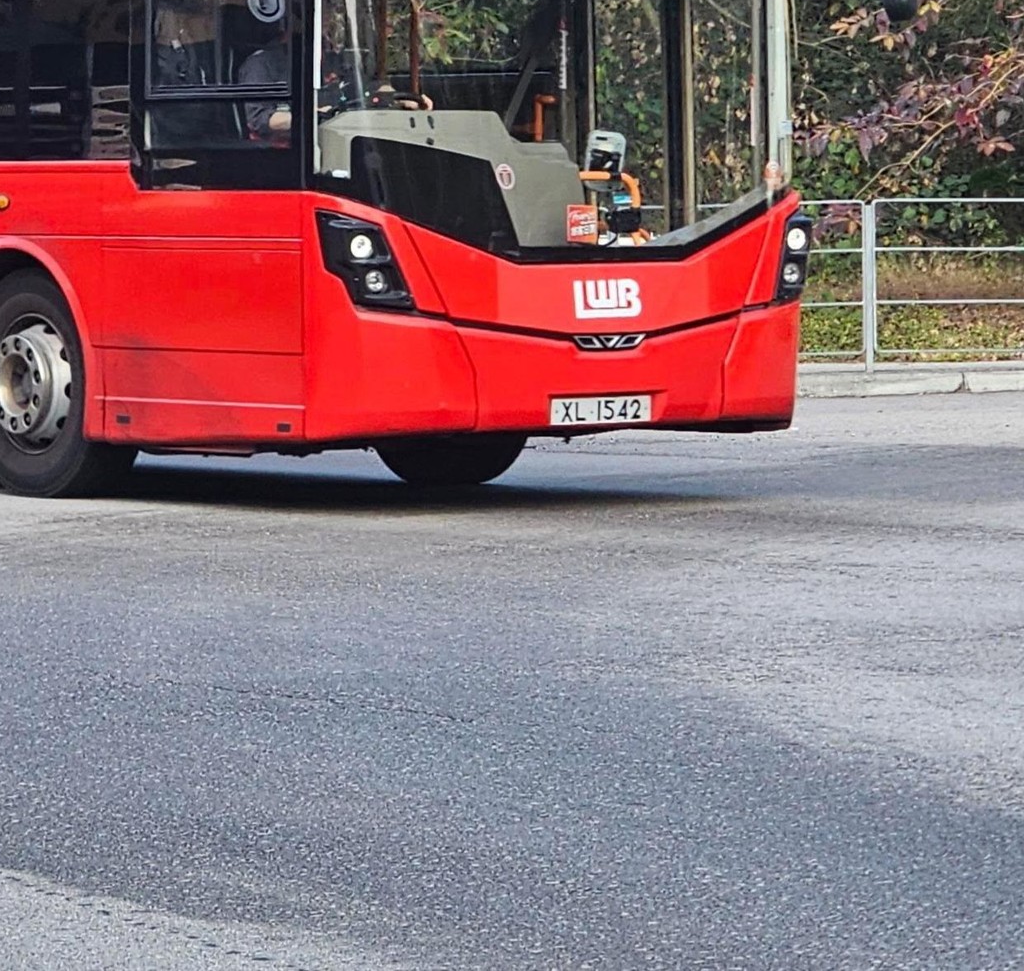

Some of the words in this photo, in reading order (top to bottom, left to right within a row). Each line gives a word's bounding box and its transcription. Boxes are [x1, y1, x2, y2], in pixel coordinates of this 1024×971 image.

[573, 278, 643, 319] LWB
[561, 401, 586, 423] XL
[597, 399, 642, 421] 1542
